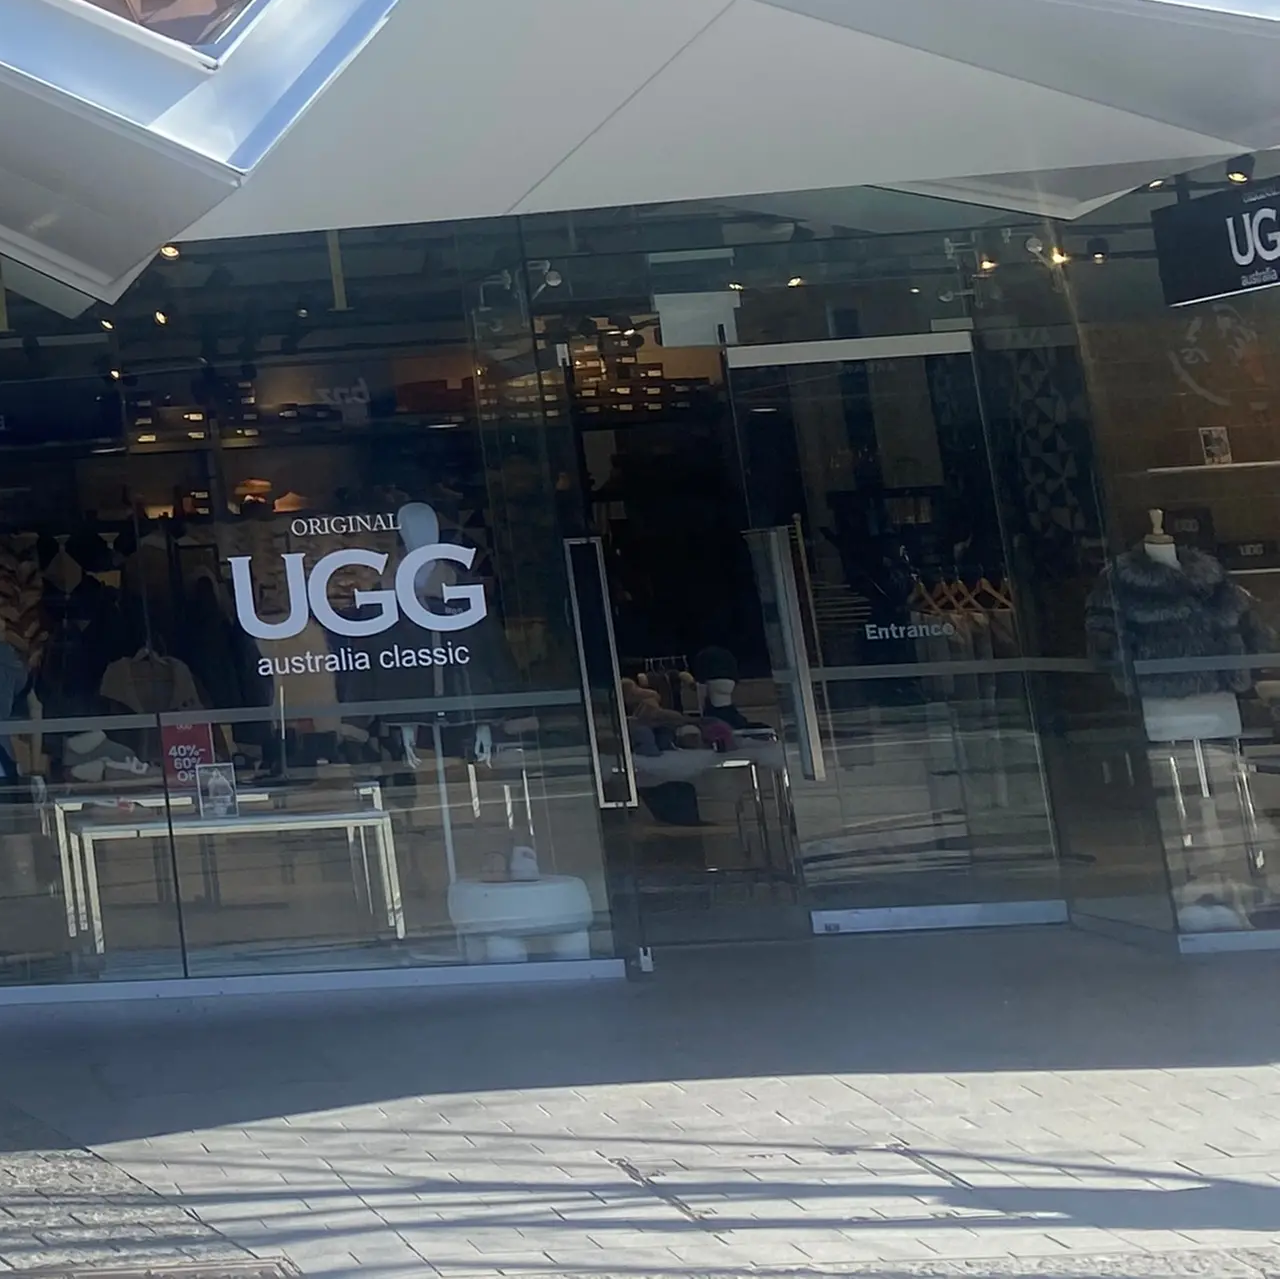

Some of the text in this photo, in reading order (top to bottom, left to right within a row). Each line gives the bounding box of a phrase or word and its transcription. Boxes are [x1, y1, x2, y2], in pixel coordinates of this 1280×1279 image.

[291, 513, 401, 537] ORIGINAL
[227, 543, 487, 640] UGG
[865, 622, 955, 640] Entrance
[257, 641, 471, 676] australia classic
[177, 770, 196, 782] OF
